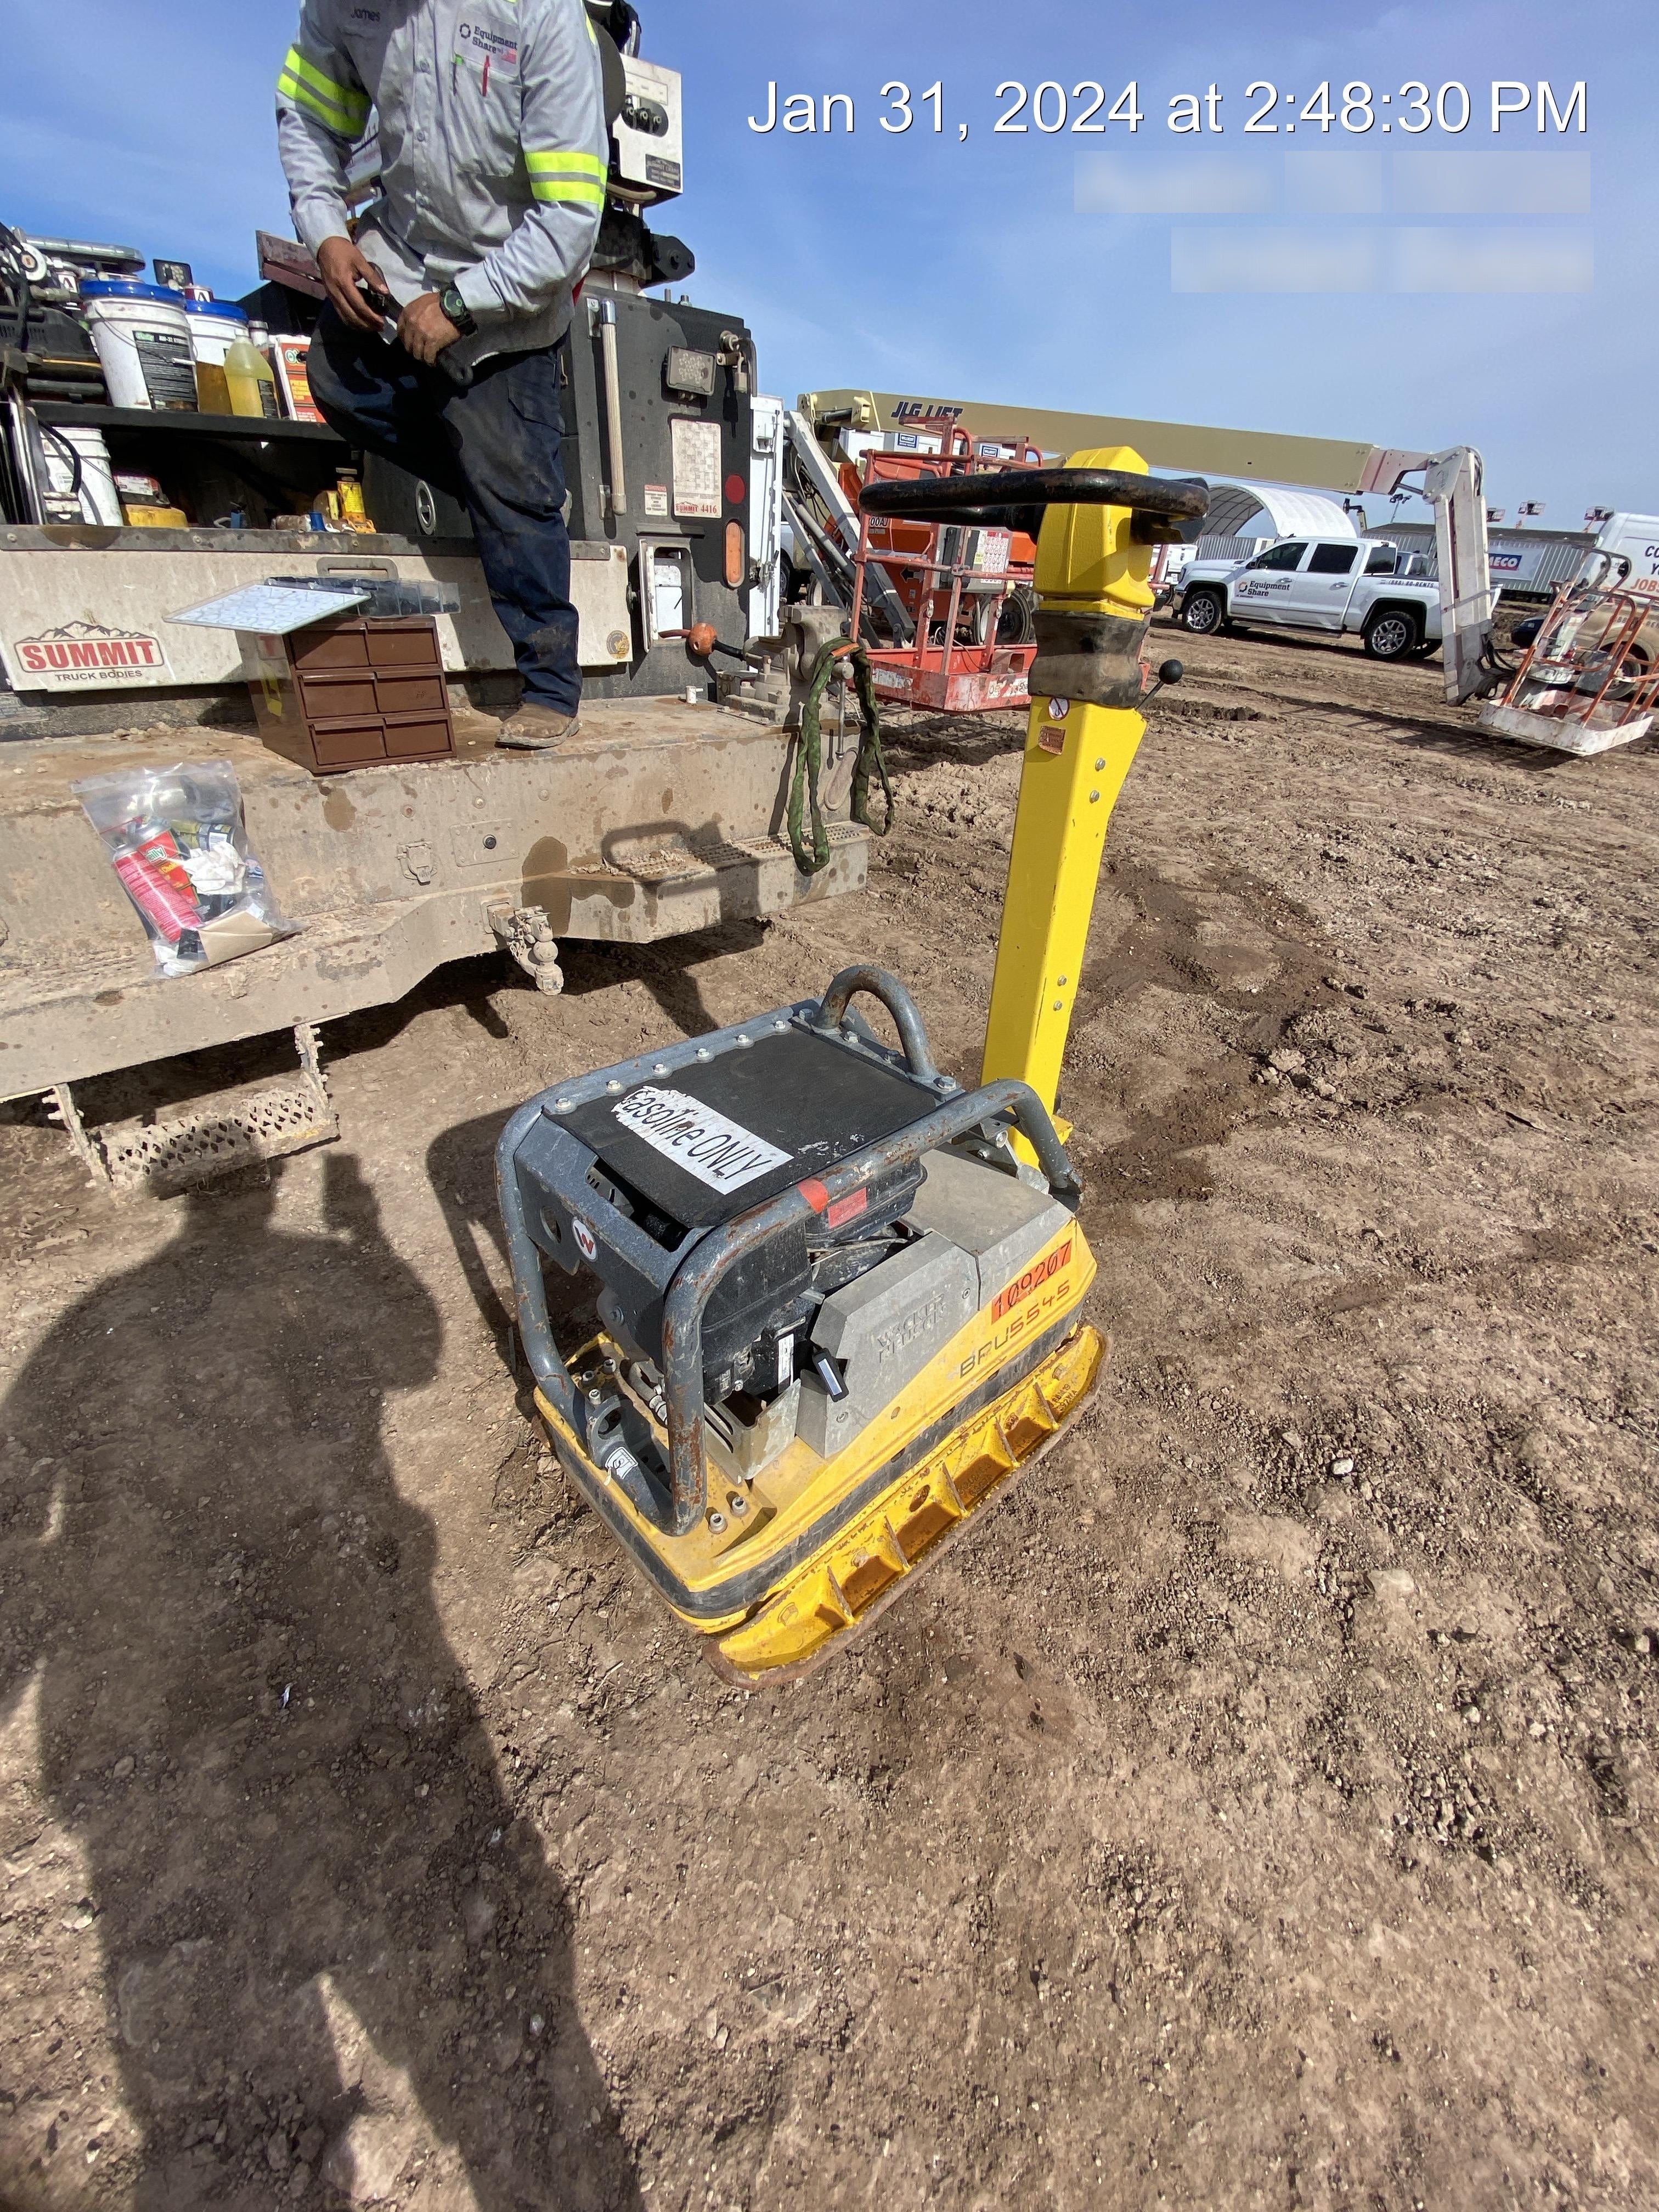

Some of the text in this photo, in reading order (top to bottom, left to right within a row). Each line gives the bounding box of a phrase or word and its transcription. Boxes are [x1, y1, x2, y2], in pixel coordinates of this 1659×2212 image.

[351, 7, 381, 22] James
[472, 36, 497, 54] Share
[473, 25, 518, 49] Equipment
[890, 401, 963, 420] JLG LIFT
[675, 503, 717, 514] SUMMIT 4416
[1247, 589, 1269, 597] Share
[1249, 580, 1290, 591] Equipment
[1630, 578, 1659, 593] JOB
[21, 641, 154, 670] SUMMIT
[55, 670, 143, 681] TRUCK BODIES
[687, 1133, 773, 1181] ONLY
[994, 1239, 1072, 1317] 109207
